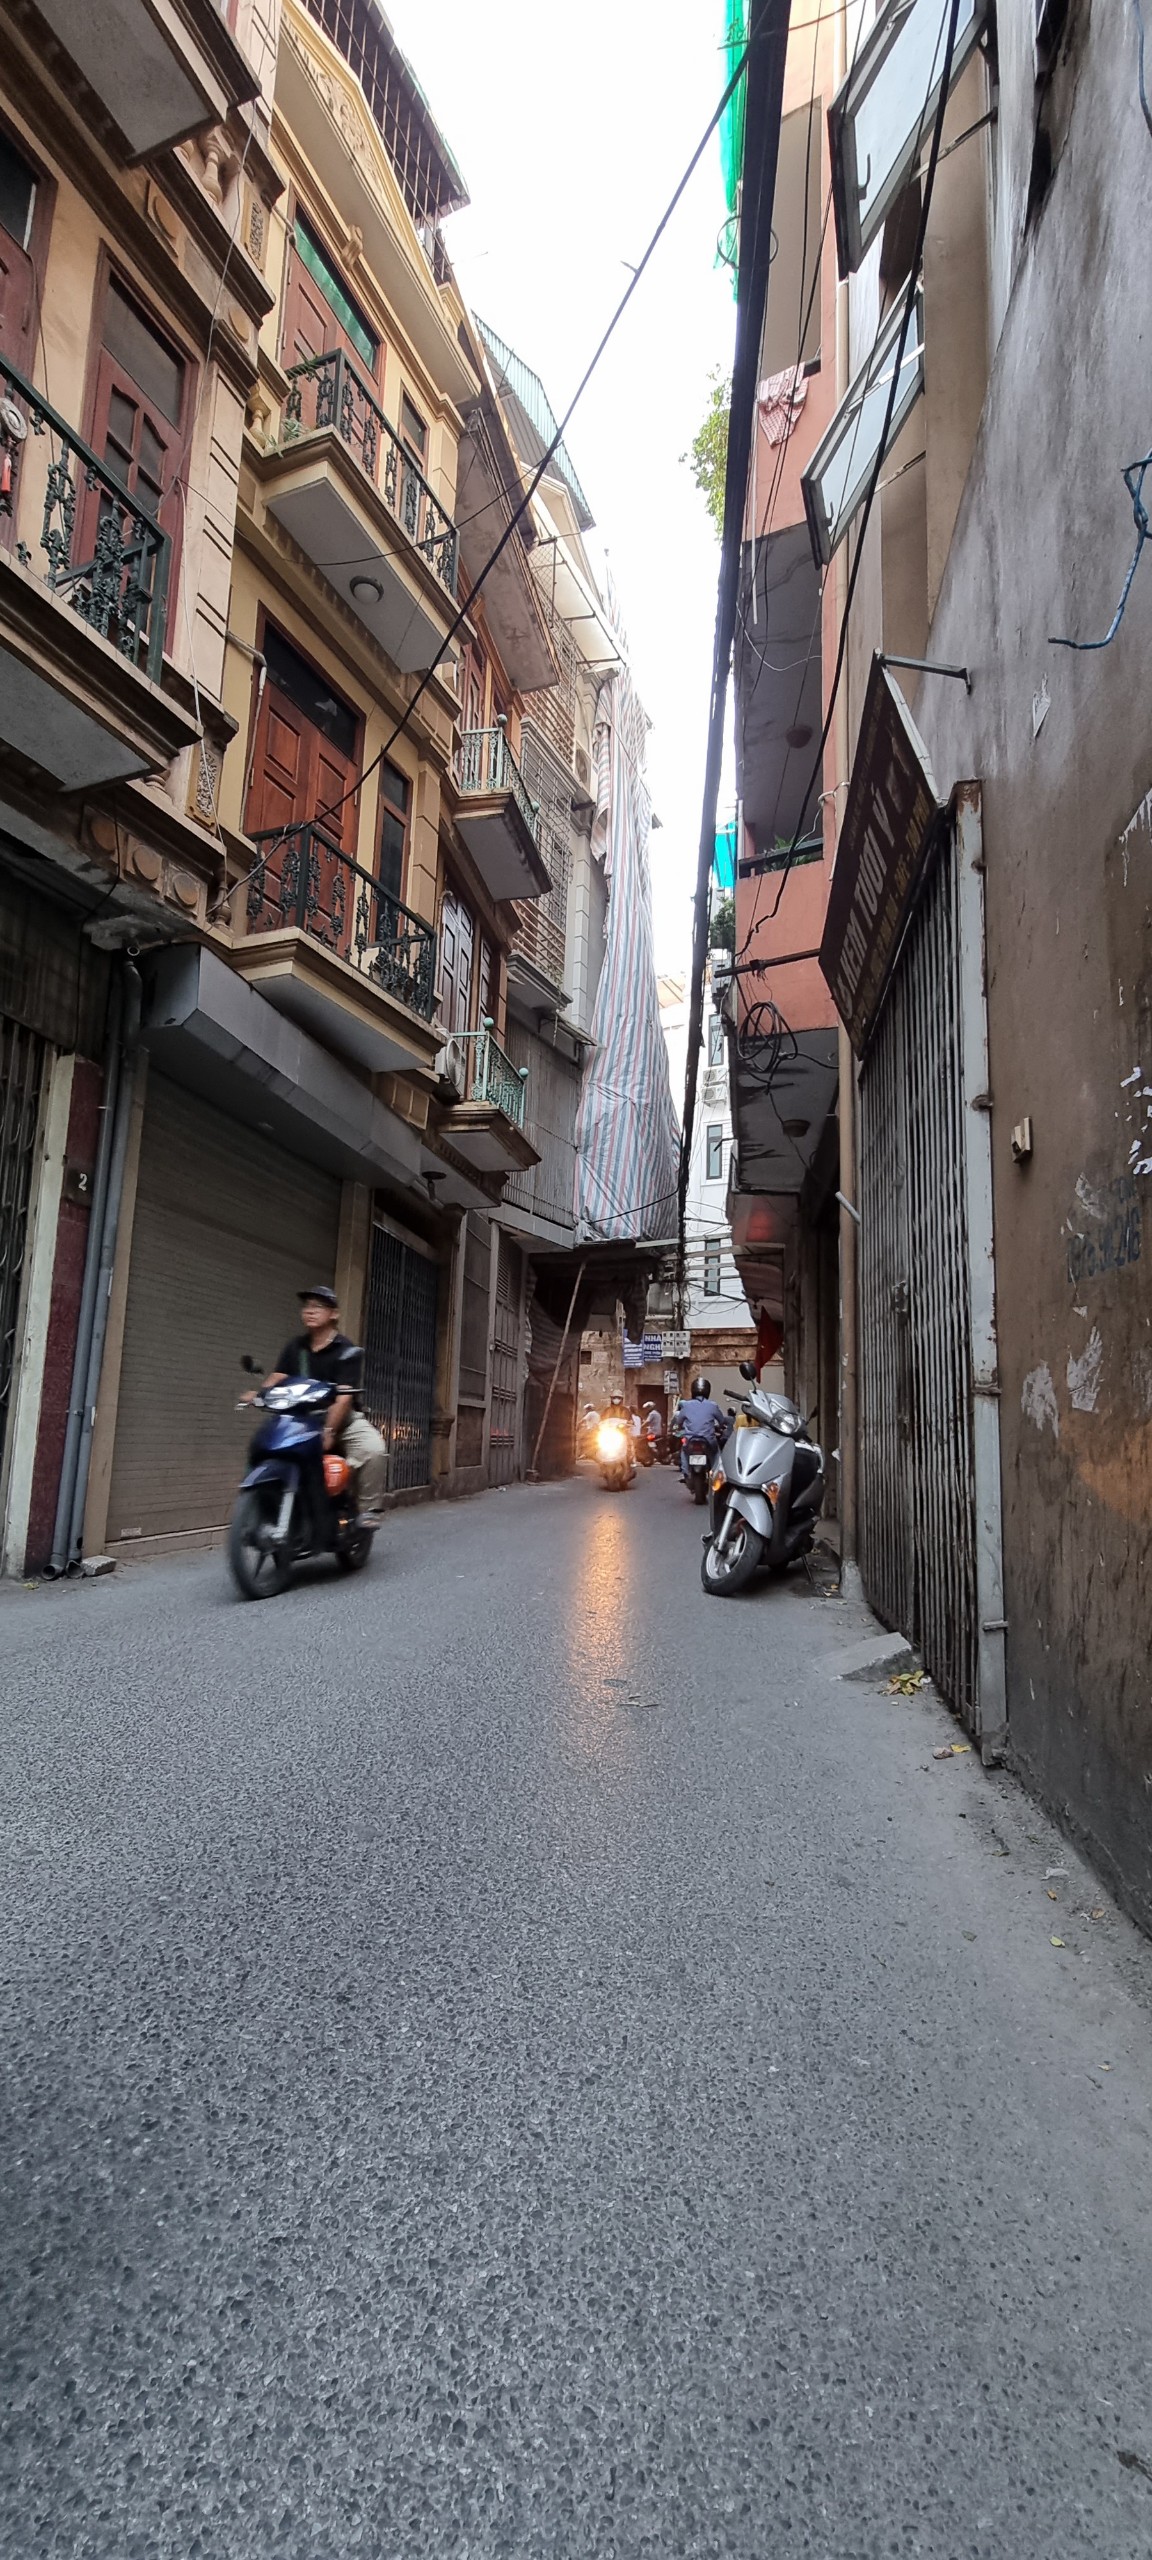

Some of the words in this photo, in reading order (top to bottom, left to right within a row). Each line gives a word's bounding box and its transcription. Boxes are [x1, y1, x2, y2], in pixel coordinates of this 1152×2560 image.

[840, 909, 868, 994] KEM
[855, 825, 887, 930] TƯƠI
[78, 1172, 88, 1191] 2
